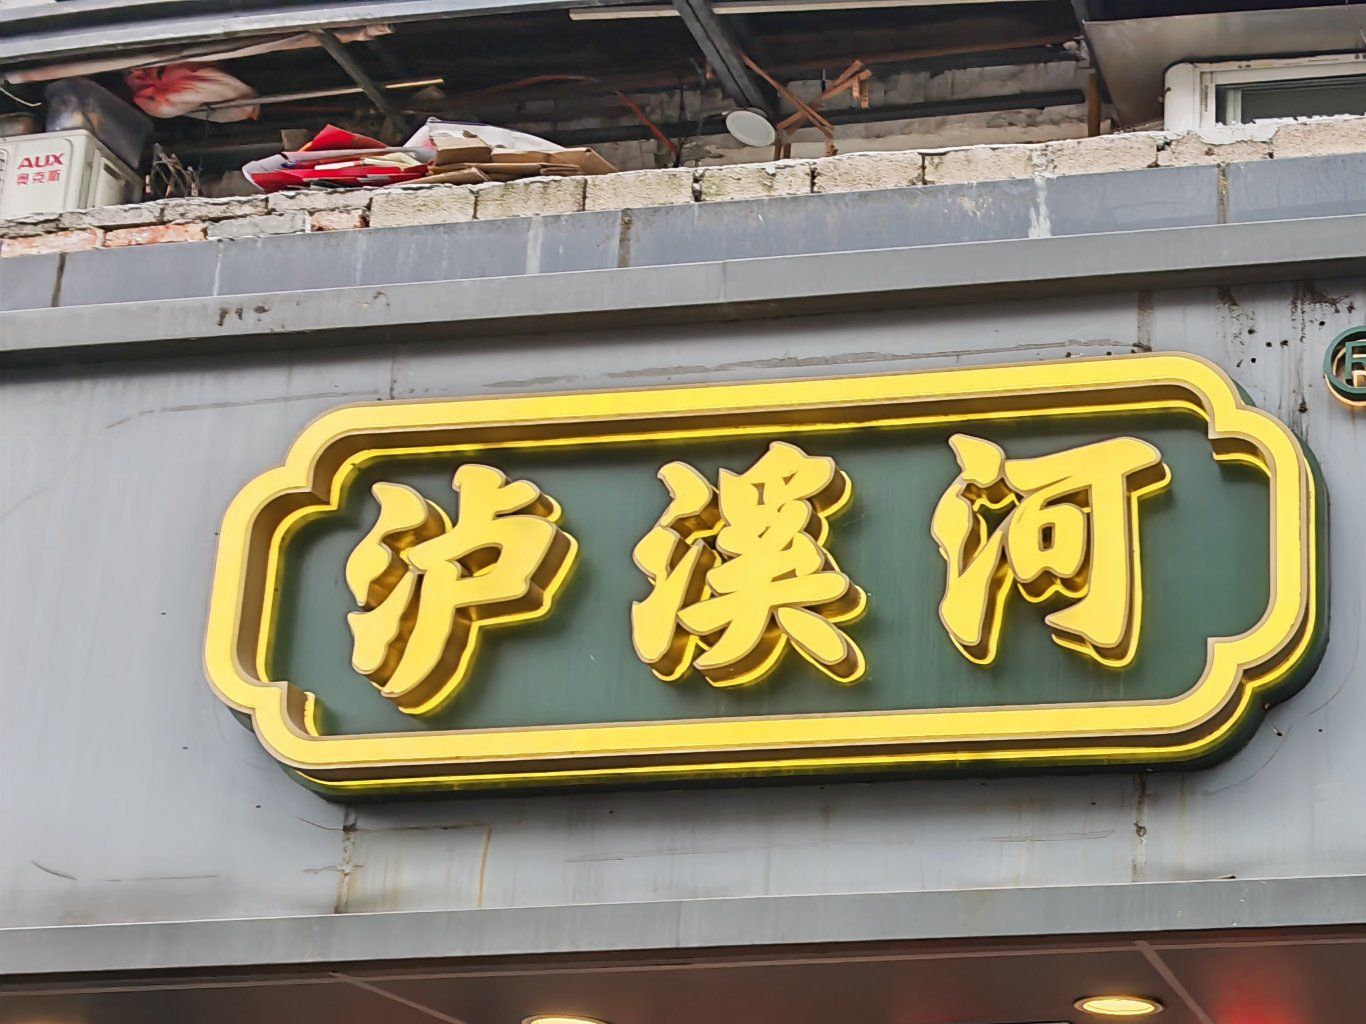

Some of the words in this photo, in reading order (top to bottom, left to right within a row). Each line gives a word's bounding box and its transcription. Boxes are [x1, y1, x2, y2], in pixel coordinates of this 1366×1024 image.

[17, 153, 64, 169] AUX
[346, 433, 1172, 716] 泸溪河
